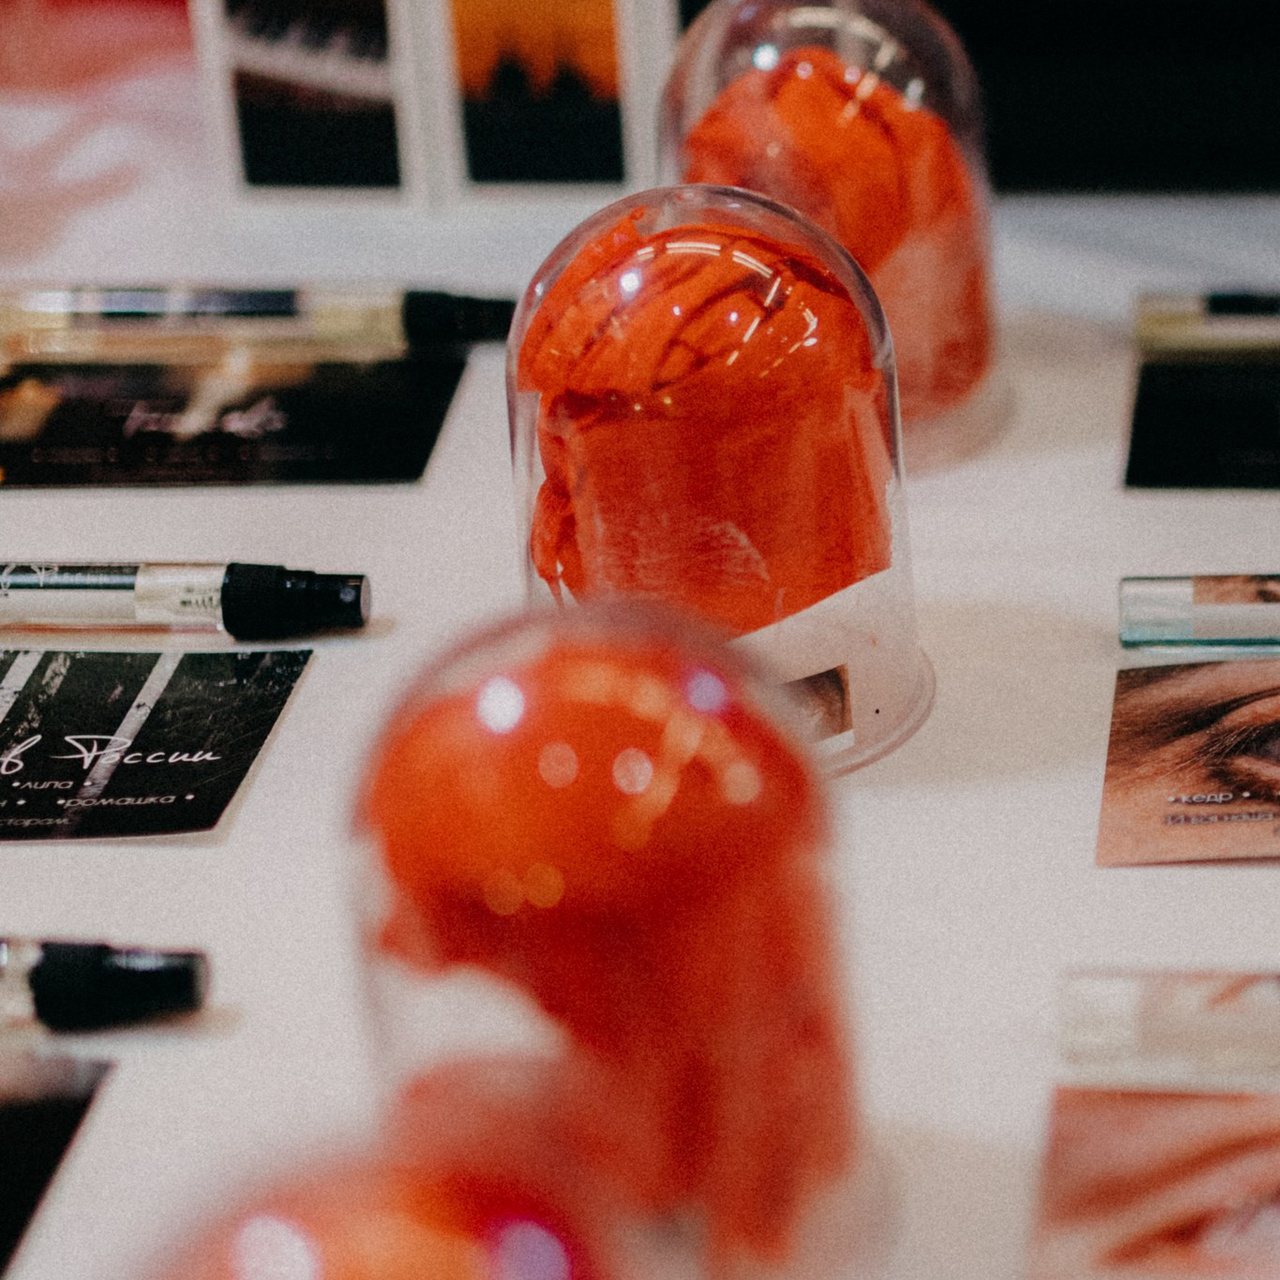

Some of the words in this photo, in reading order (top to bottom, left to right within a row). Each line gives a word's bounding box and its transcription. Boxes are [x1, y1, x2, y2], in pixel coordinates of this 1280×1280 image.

[51, 734, 222, 770] России
[20, 780, 74, 790] липа
[64, 794, 176, 809] ромашка
[1181, 791, 1234, 805] кедр
